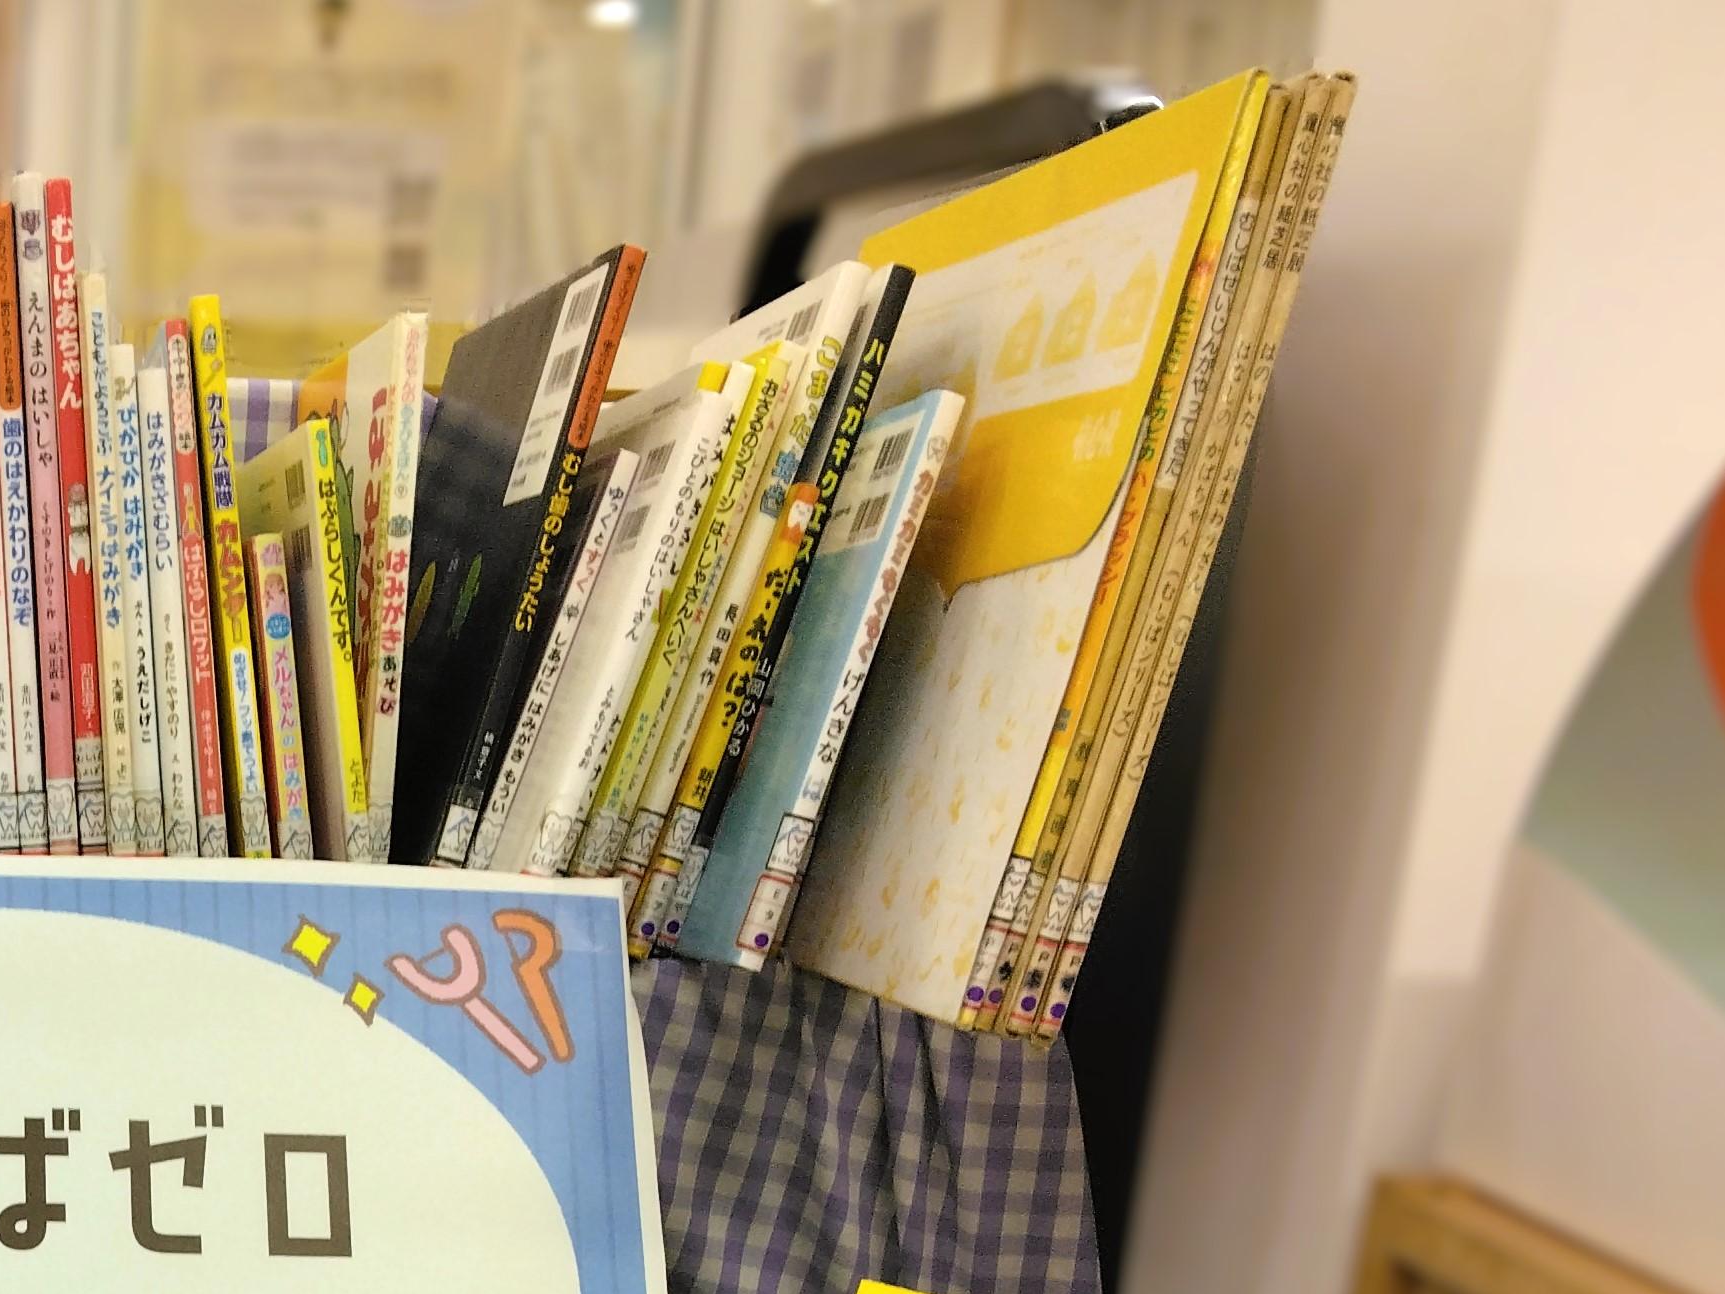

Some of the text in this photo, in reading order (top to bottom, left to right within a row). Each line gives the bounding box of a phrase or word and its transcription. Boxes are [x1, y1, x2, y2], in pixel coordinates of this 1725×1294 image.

[2, 418, 33, 626] 歯のはえかわりのなぞ
[717, 378, 779, 514] おさるのジョージ
[785, 338, 886, 597] ハミガキクエスト
[184, 545, 212, 684] はぶらしロケット
[319, 480, 353, 663] はぶらしくんです。
[515, 452, 582, 633] むし歯のしょうたい
[137, 647, 152, 744] うえだしげこ
